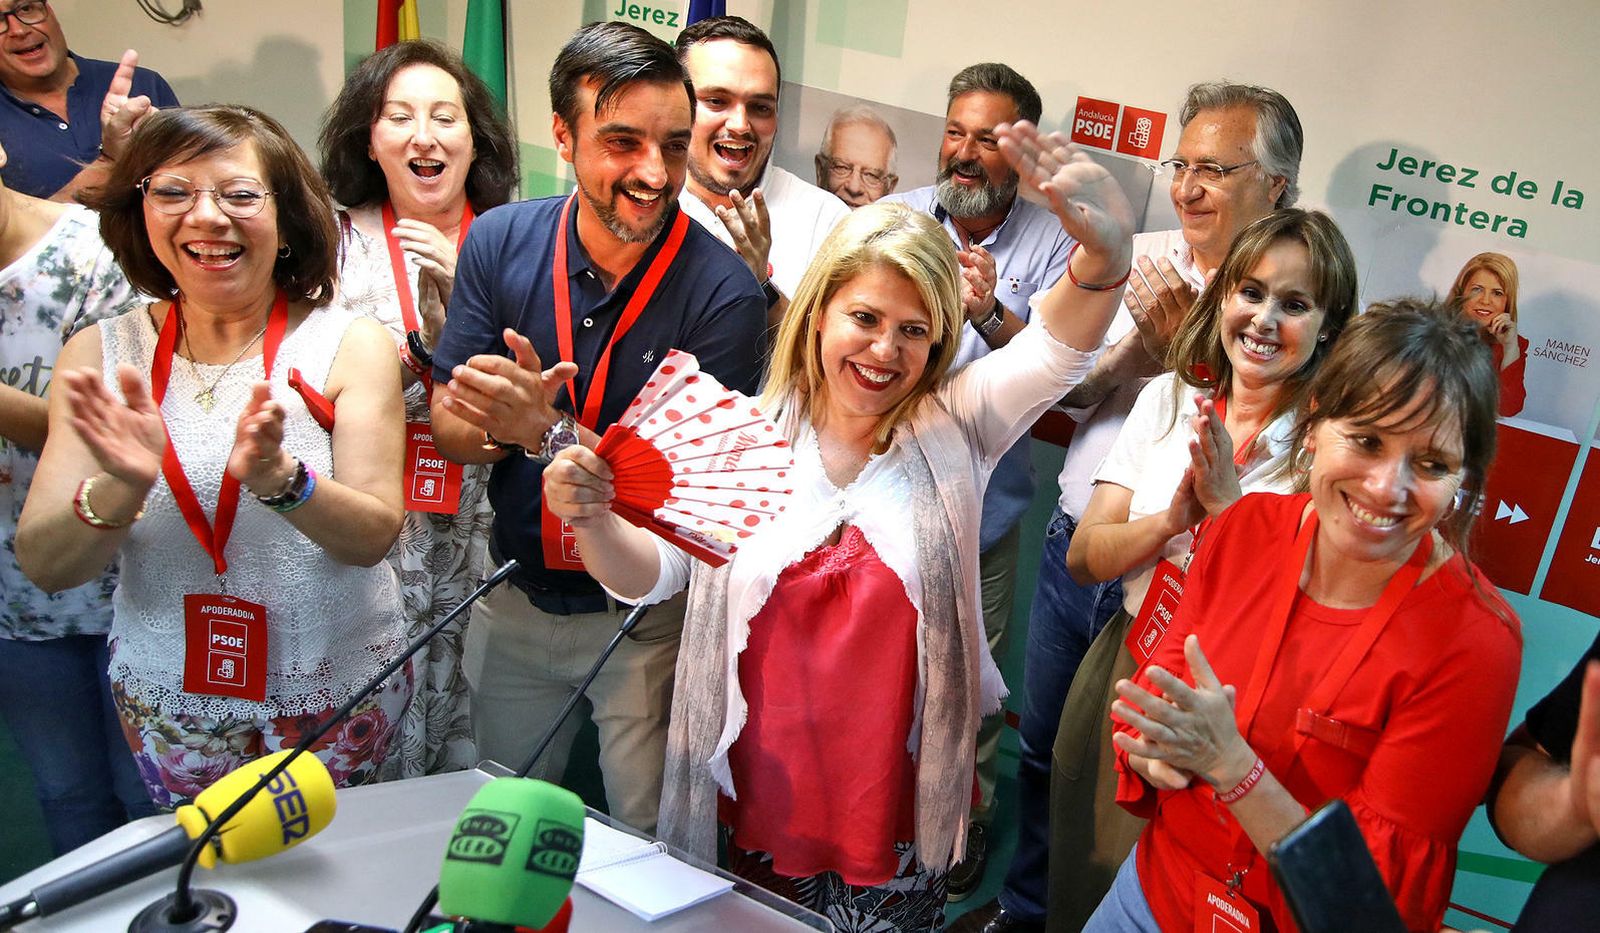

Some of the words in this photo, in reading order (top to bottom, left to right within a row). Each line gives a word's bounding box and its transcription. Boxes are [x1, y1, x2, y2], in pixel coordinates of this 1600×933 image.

[614, 0, 680, 28] Jerez
[1078, 108, 1115, 122] Andalucía
[1074, 118, 1114, 140] PSOE
[1376, 148, 1479, 188] Jerez
[1490, 171, 1538, 200] de
[1550, 180, 1585, 209] la
[1367, 183, 1529, 239] Frontera
[1546, 338, 1590, 357] MAMEN
[418, 458, 444, 469] PSOE
[200, 605, 255, 621] APODERADO/A
[1156, 603, 1173, 625] PSOE
[212, 633, 244, 648] PSOE
[1206, 892, 1251, 929] APODERADO/A
